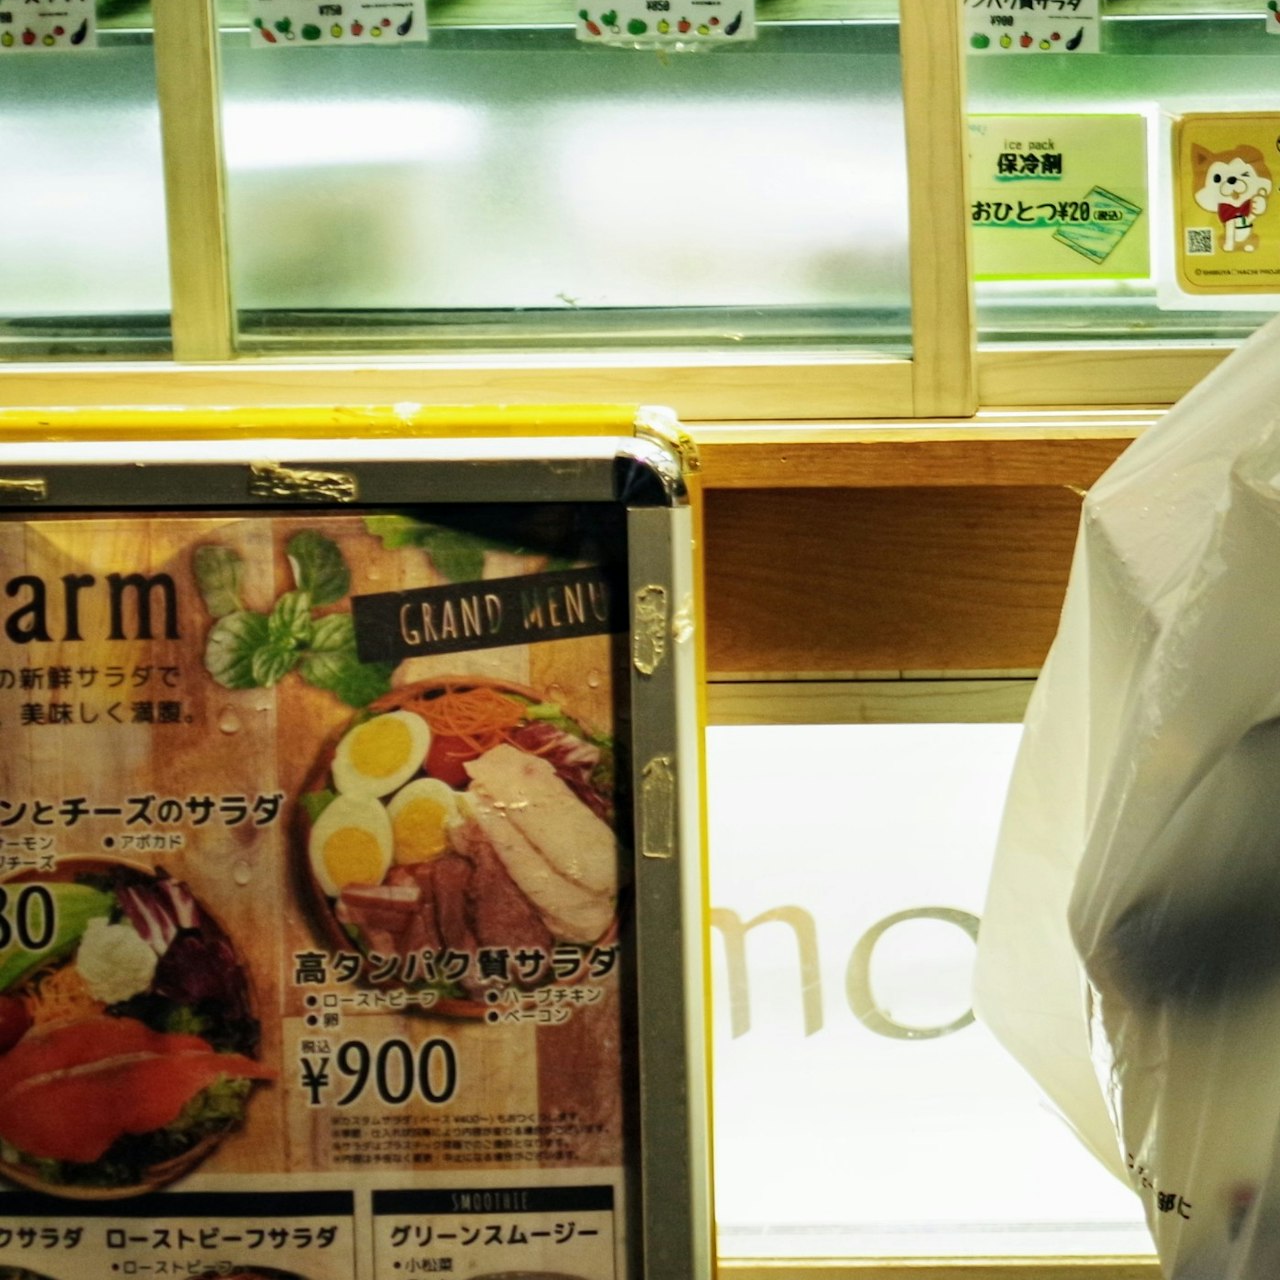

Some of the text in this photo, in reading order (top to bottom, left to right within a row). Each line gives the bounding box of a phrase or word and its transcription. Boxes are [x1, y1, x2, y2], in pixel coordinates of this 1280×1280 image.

[1004, 137, 1056, 151] ice pack
[997, 152, 1063, 176] 保冷剤
[399, 581, 611, 646] GRAND MENU
[0, 665, 181, 690] の新鮮サラダで
[0, 793, 281, 827] ンとチーズのサラダ
[0, 834, 182, 851] ーモン アボカド
[295, 945, 621, 986] 高タンパク質サラダ
[323, 987, 602, 1008] ローストビーフ ハーブチキン
[504, 1009, 570, 1024] ベーコン
[301, 1039, 332, 1055] 税込
[299, 1038, 458, 1107] ¥900
[450, 1191, 529, 1212] SMOOTHIE
[106, 1224, 340, 1250] ローストビーフサラダ
[389, 1222, 600, 1249] グリーンスムージー
[121, 1256, 454, 1276] ローストビーフ 小松菜
